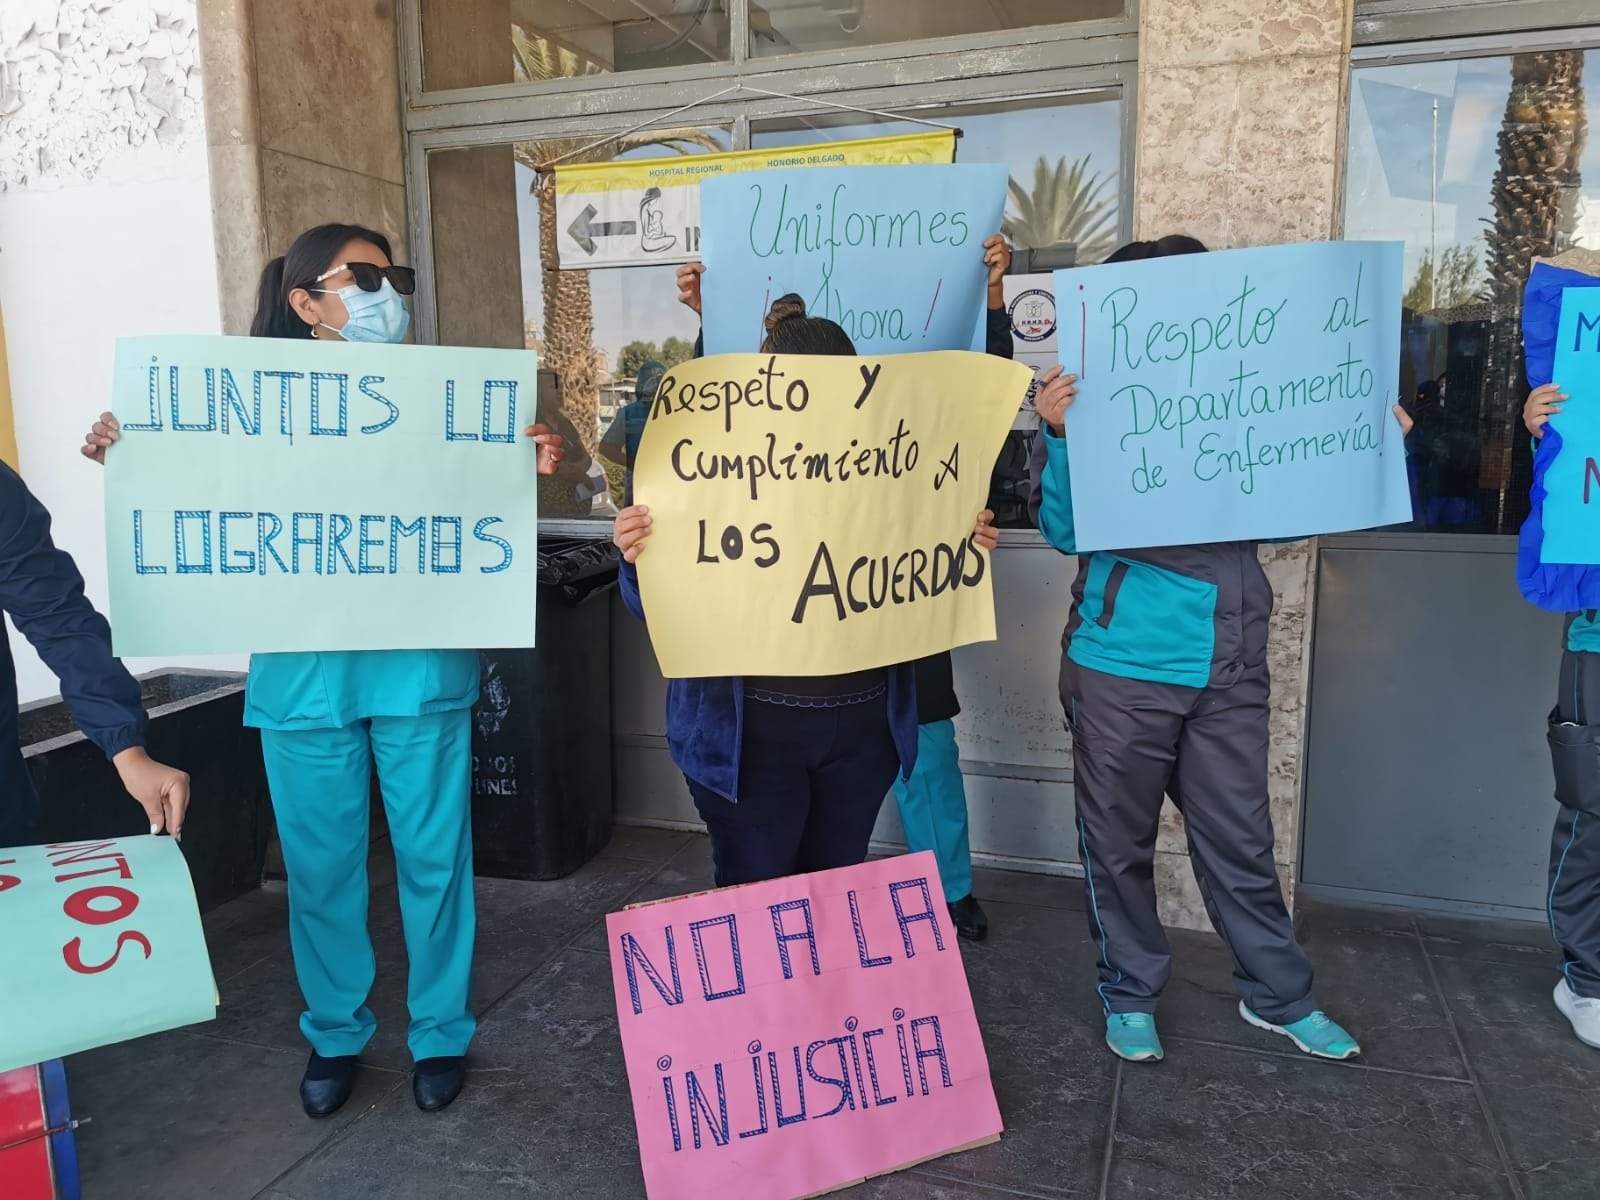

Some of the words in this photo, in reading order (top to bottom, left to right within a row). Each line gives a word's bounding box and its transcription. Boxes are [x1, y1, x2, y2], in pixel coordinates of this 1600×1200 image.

[649, 168, 684, 177] HOSPITAL
[686, 164, 724, 174] REGIONAL
[767, 158, 805, 167] HONORIO
[807, 154, 845, 164] DELGADO
[750, 183, 968, 276] Uniformes
[446, 380, 518, 443] LO
[652, 356, 809, 432] Respeto
[1110, 342, 1374, 452] Departamento
[671, 419, 919, 500] Cumplimiento
[1132, 447, 1168, 494] de
[133, 509, 513, 576] LOGRAREMOS
[696, 520, 780, 568] LOS
[791, 535, 985, 624] ACUERDOS
[621, 914, 746, 1015] NO
[769, 898, 821, 980] A
[847, 877, 944, 969] LA
